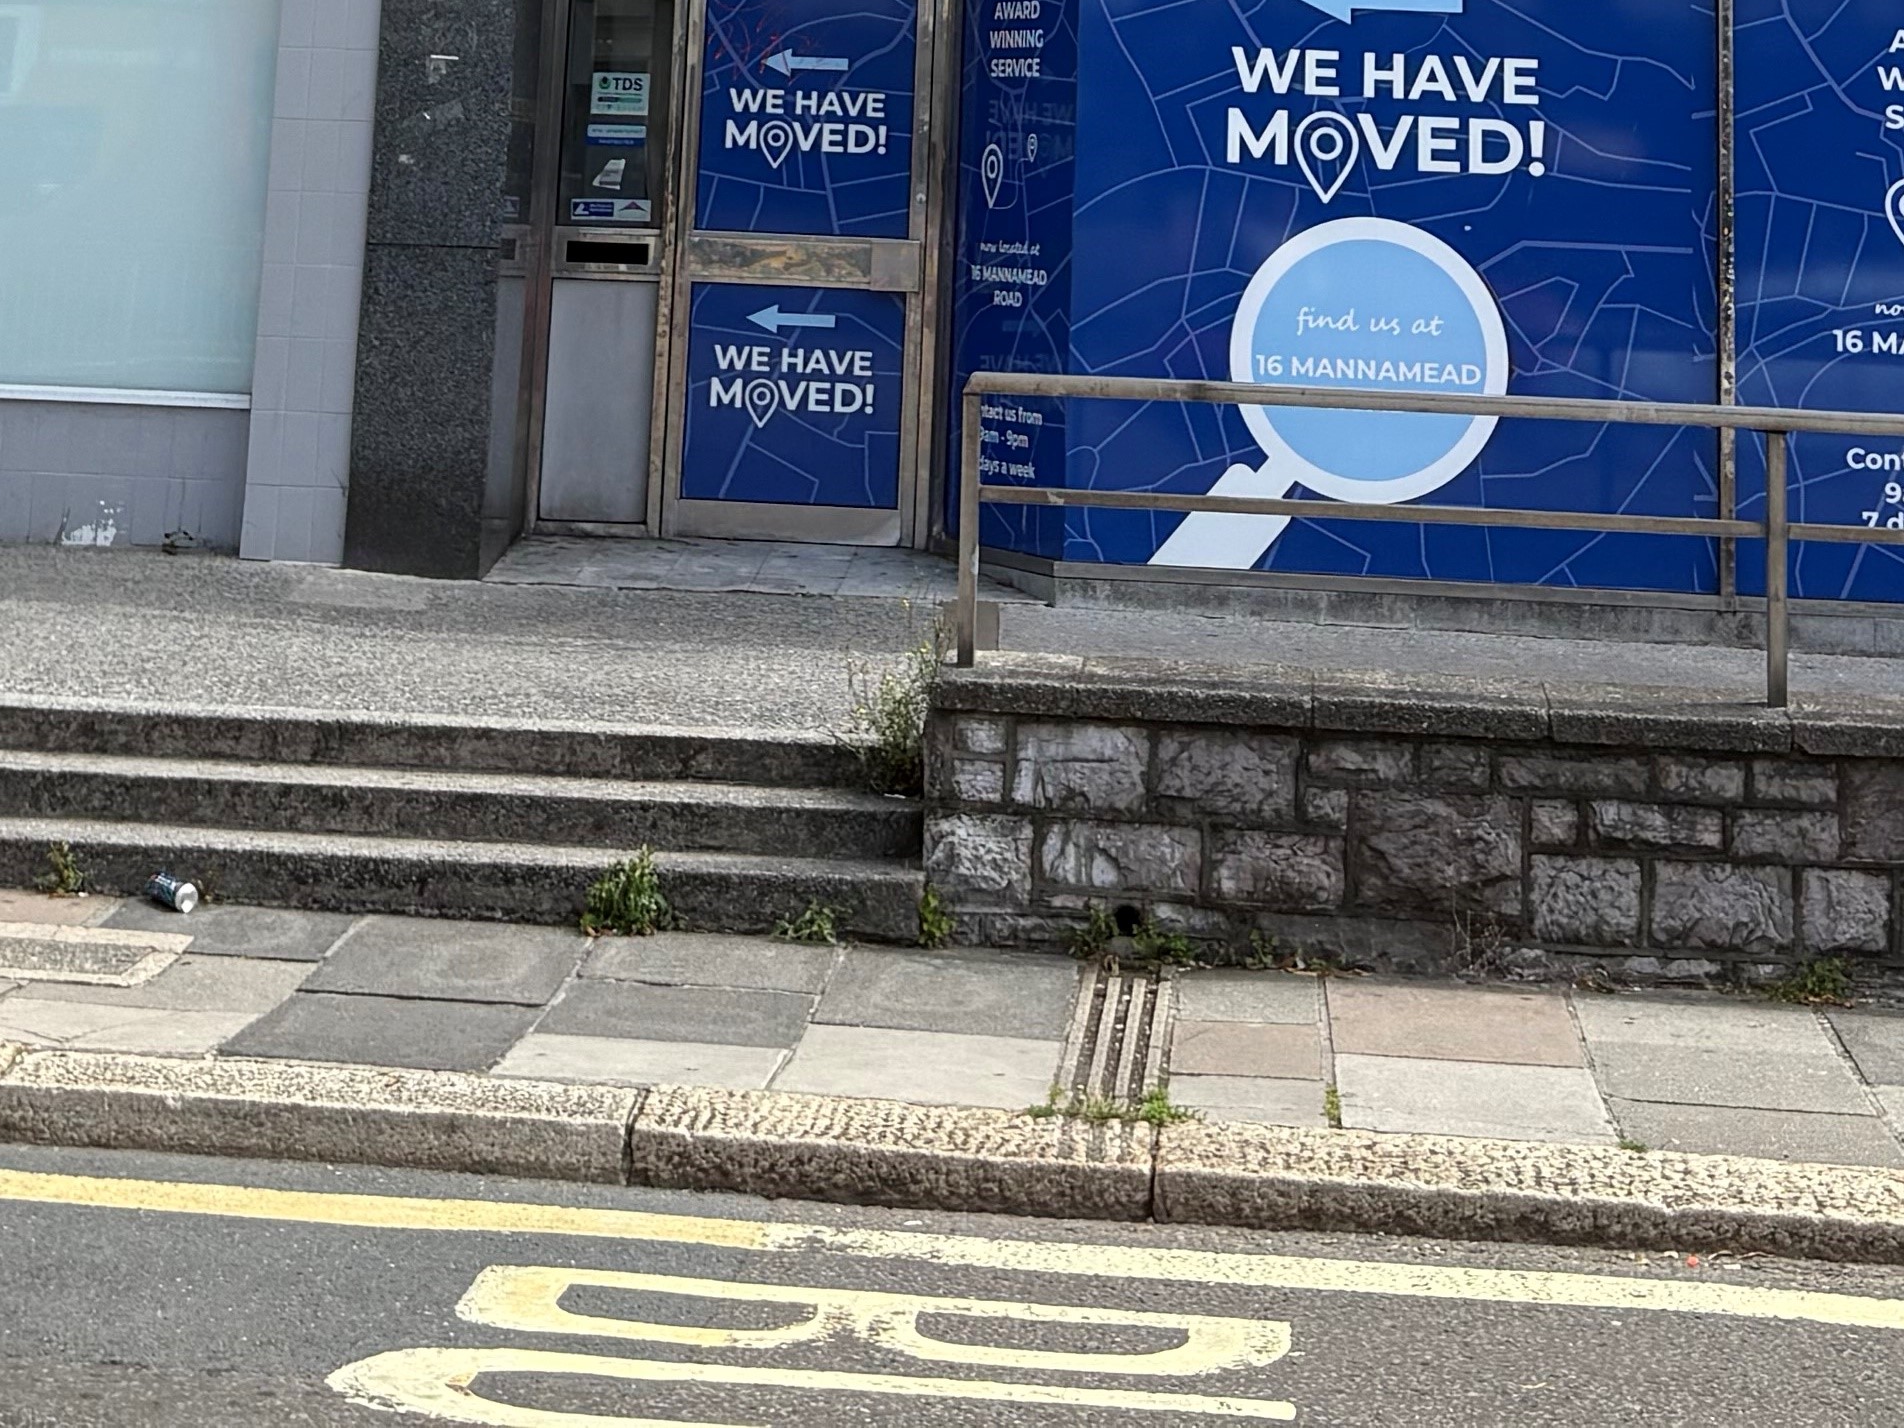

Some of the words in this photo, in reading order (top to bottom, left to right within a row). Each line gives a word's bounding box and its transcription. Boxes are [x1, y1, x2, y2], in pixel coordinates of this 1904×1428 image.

[994, 0, 1042, 21] AWARD
[989, 29, 1045, 49] WINNING
[990, 57, 1042, 78] SERVICE
[1231, 45, 1341, 97] WE
[1362, 51, 1540, 105] HAVE
[612, 76, 644, 92] TDS
[729, 87, 786, 114] WE
[795, 90, 886, 118] HAVE
[982, 265, 1048, 287] MANNAMEAD
[992, 289, 1023, 308] ROAD
[1296, 305, 1360, 337] find
[1369, 316, 1401, 336] us
[1411, 314, 1445, 337] at
[1832, 328, 1864, 354] 16
[713, 343, 772, 372] WE
[780, 347, 874, 377] HAVE
[1255, 353, 1284, 377] 16
[1290, 354, 1482, 386] MANNAMEAD
[980, 403, 1003, 420] ntact
[1861, 510, 1880, 528] 7
